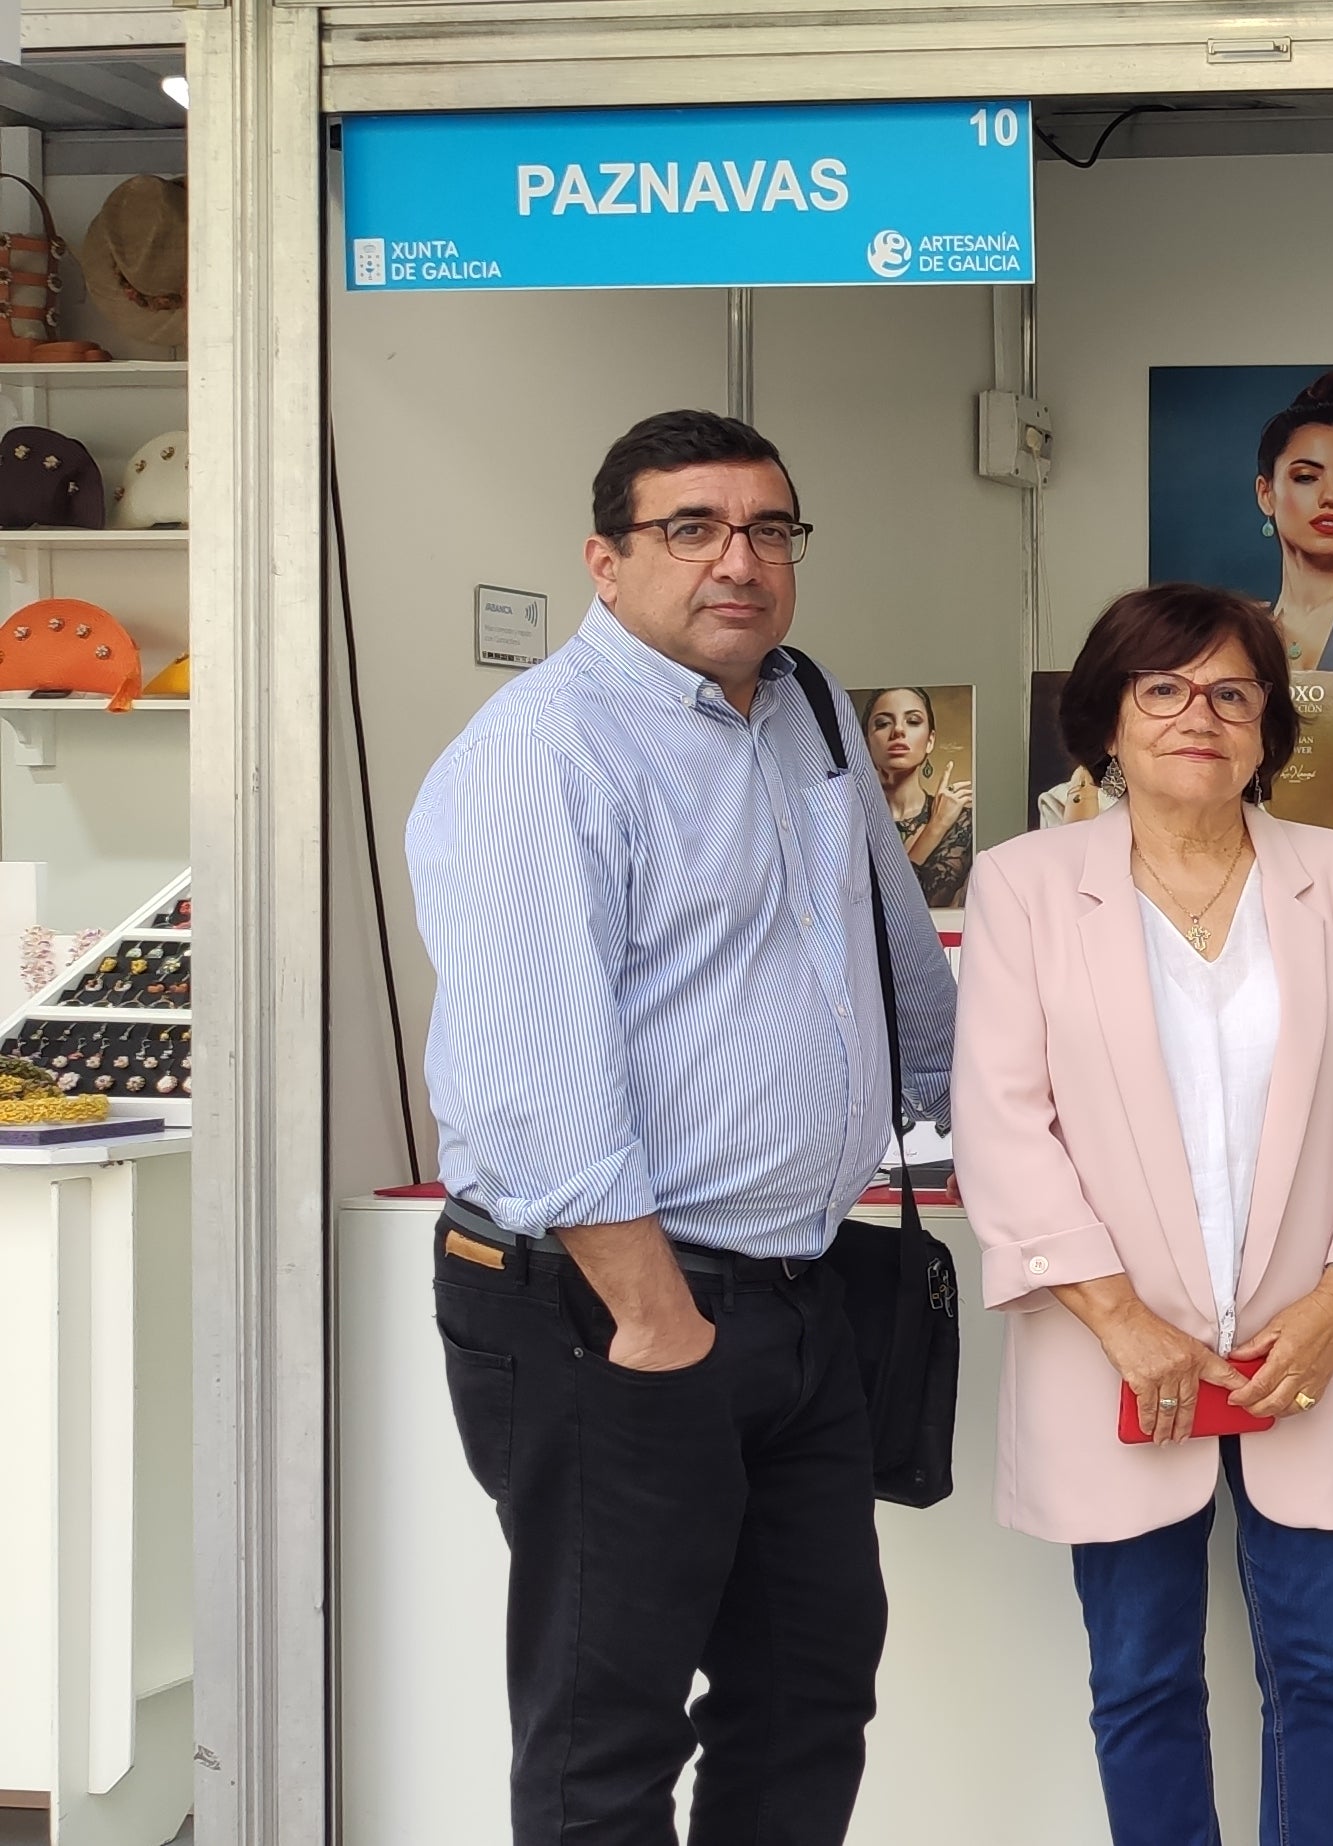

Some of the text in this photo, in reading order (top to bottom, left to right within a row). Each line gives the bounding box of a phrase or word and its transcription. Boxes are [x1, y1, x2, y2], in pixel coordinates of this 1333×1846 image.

[968, 108, 1019, 147] 10
[517, 156, 850, 217] PAZNAVAS
[391, 240, 459, 260] XUNTA
[918, 230, 1020, 252] ARTESANÍA
[391, 259, 502, 281] DE GALICIA
[919, 253, 1021, 272] DE GALICIA
